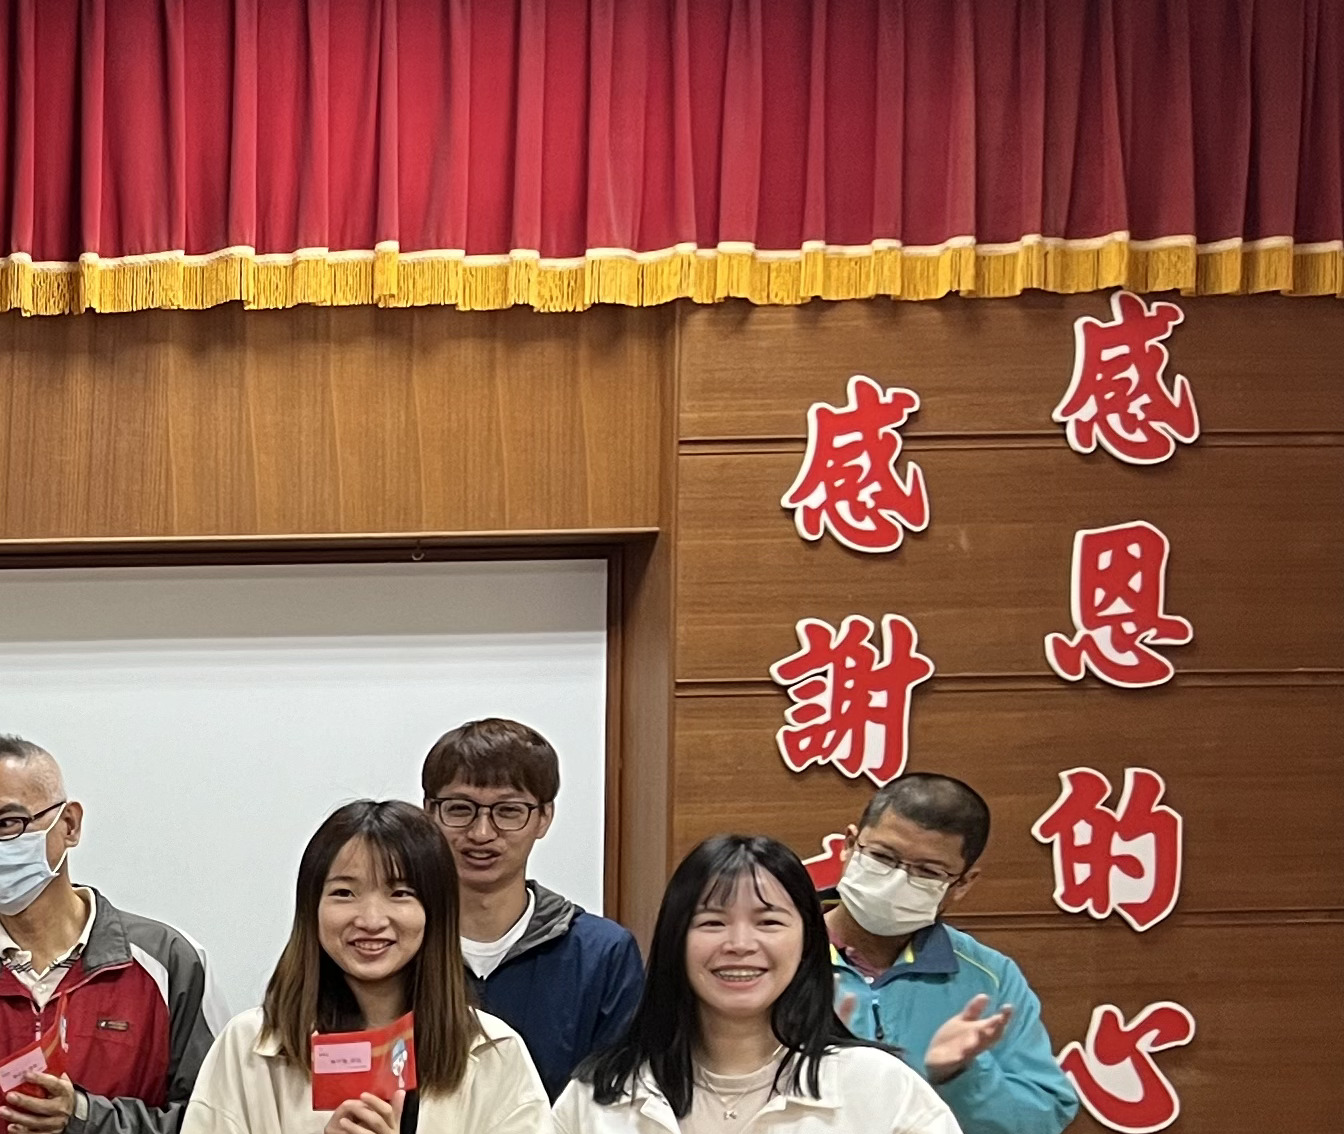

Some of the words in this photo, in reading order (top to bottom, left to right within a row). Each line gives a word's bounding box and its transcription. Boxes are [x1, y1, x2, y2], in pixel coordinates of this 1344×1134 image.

[770, 375, 935, 889] 感謝
[1032, 290, 1200, 1134] 感恩的心
